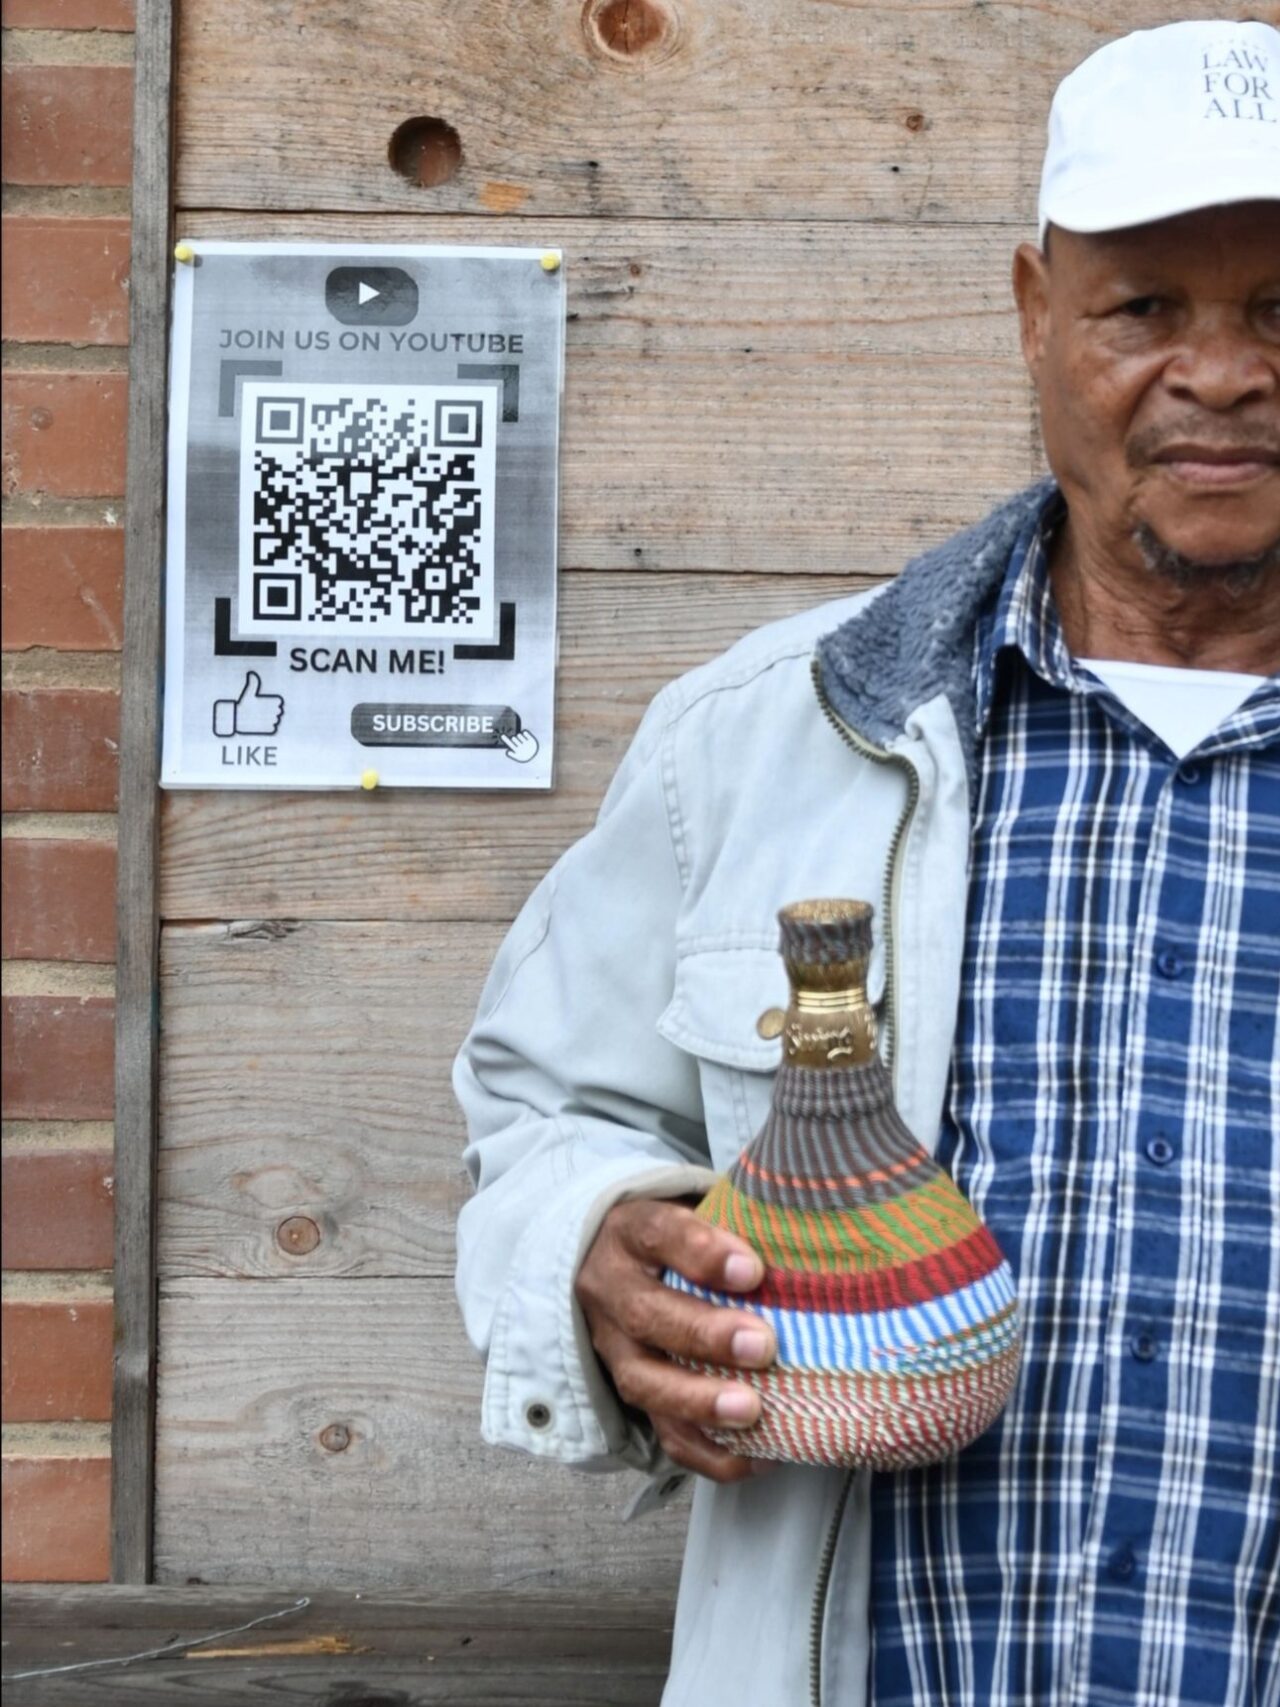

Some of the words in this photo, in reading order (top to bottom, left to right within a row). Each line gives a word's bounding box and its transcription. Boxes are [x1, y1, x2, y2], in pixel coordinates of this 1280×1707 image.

[1202, 48, 1268, 73] LAW
[1203, 72, 1273, 100] FOR
[1203, 98, 1278, 123] ALL
[219, 329, 284, 349] JOIN
[295, 330, 330, 350] US
[339, 331, 379, 351] ON
[389, 332, 524, 353] YOUTUBE
[289, 647, 377, 674] SCAN
[388, 649, 445, 674] ME!
[372, 714, 494, 734] SUBSCRIBE
[221, 745, 278, 766] LIKE
